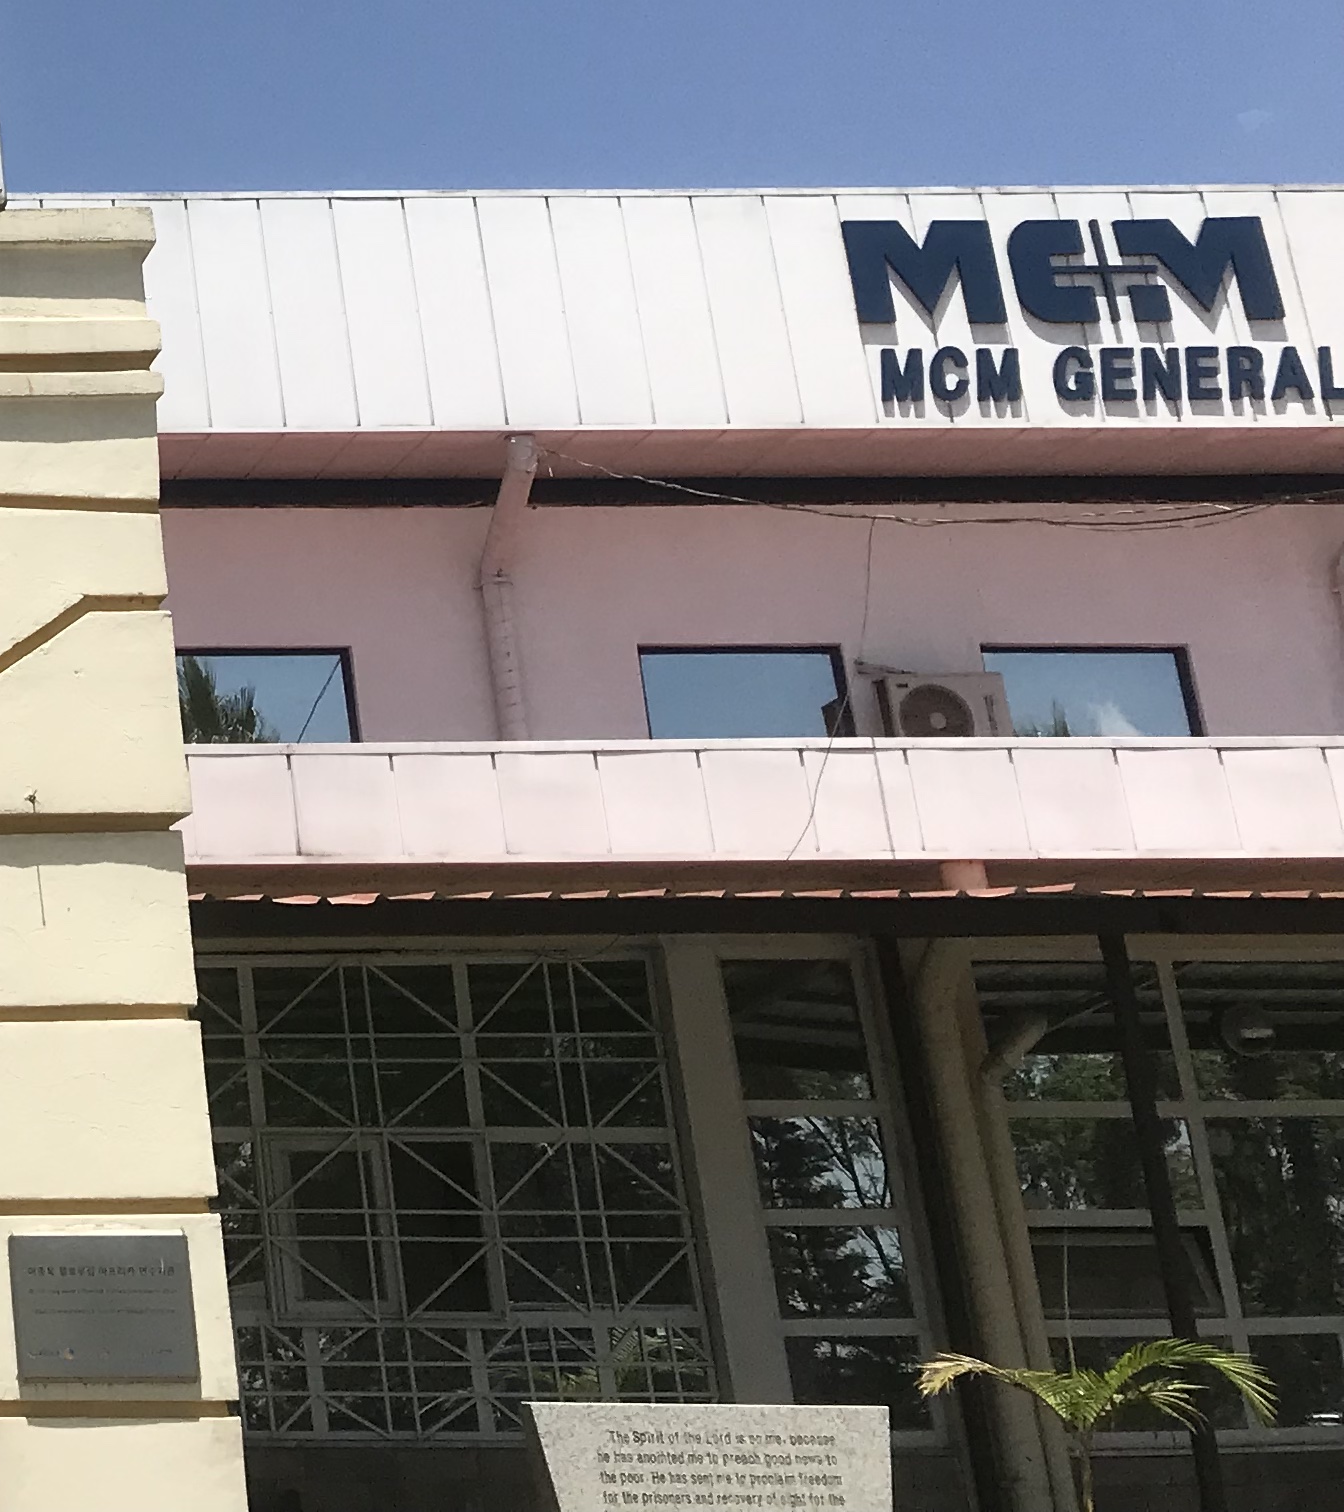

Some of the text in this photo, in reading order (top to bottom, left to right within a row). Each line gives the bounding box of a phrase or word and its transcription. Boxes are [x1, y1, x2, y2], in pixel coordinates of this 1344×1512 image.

[881, 345, 1344, 402] MCM GENERAL
[606, 1430, 630, 1444] The
[633, 1431, 665, 1446] Spirit
[668, 1432, 680, 1445] of
[684, 1432, 701, 1445] the
[706, 1432, 731, 1445] Lord
[597, 1450, 610, 1464] he
[614, 1451, 633, 1464] has
[688, 1453, 704, 1465] me
[706, 1452, 718, 1465] to
[722, 1453, 761, 1467] preach
[764, 1453, 792, 1468] good
[825, 1454, 837, 1466] to
[600, 1471, 617, 1484] the
[652, 1472, 666, 1484] He
[669, 1472, 688, 1485] has
[735, 1473, 746, 1485] to
[603, 1491, 618, 1504] for
[622, 1491, 639, 1505] the
[642, 1492, 692, 1506] prisoners
[695, 1492, 714, 1505] and
[809, 1492, 825, 1507] for
[828, 1493, 846, 1506] the
